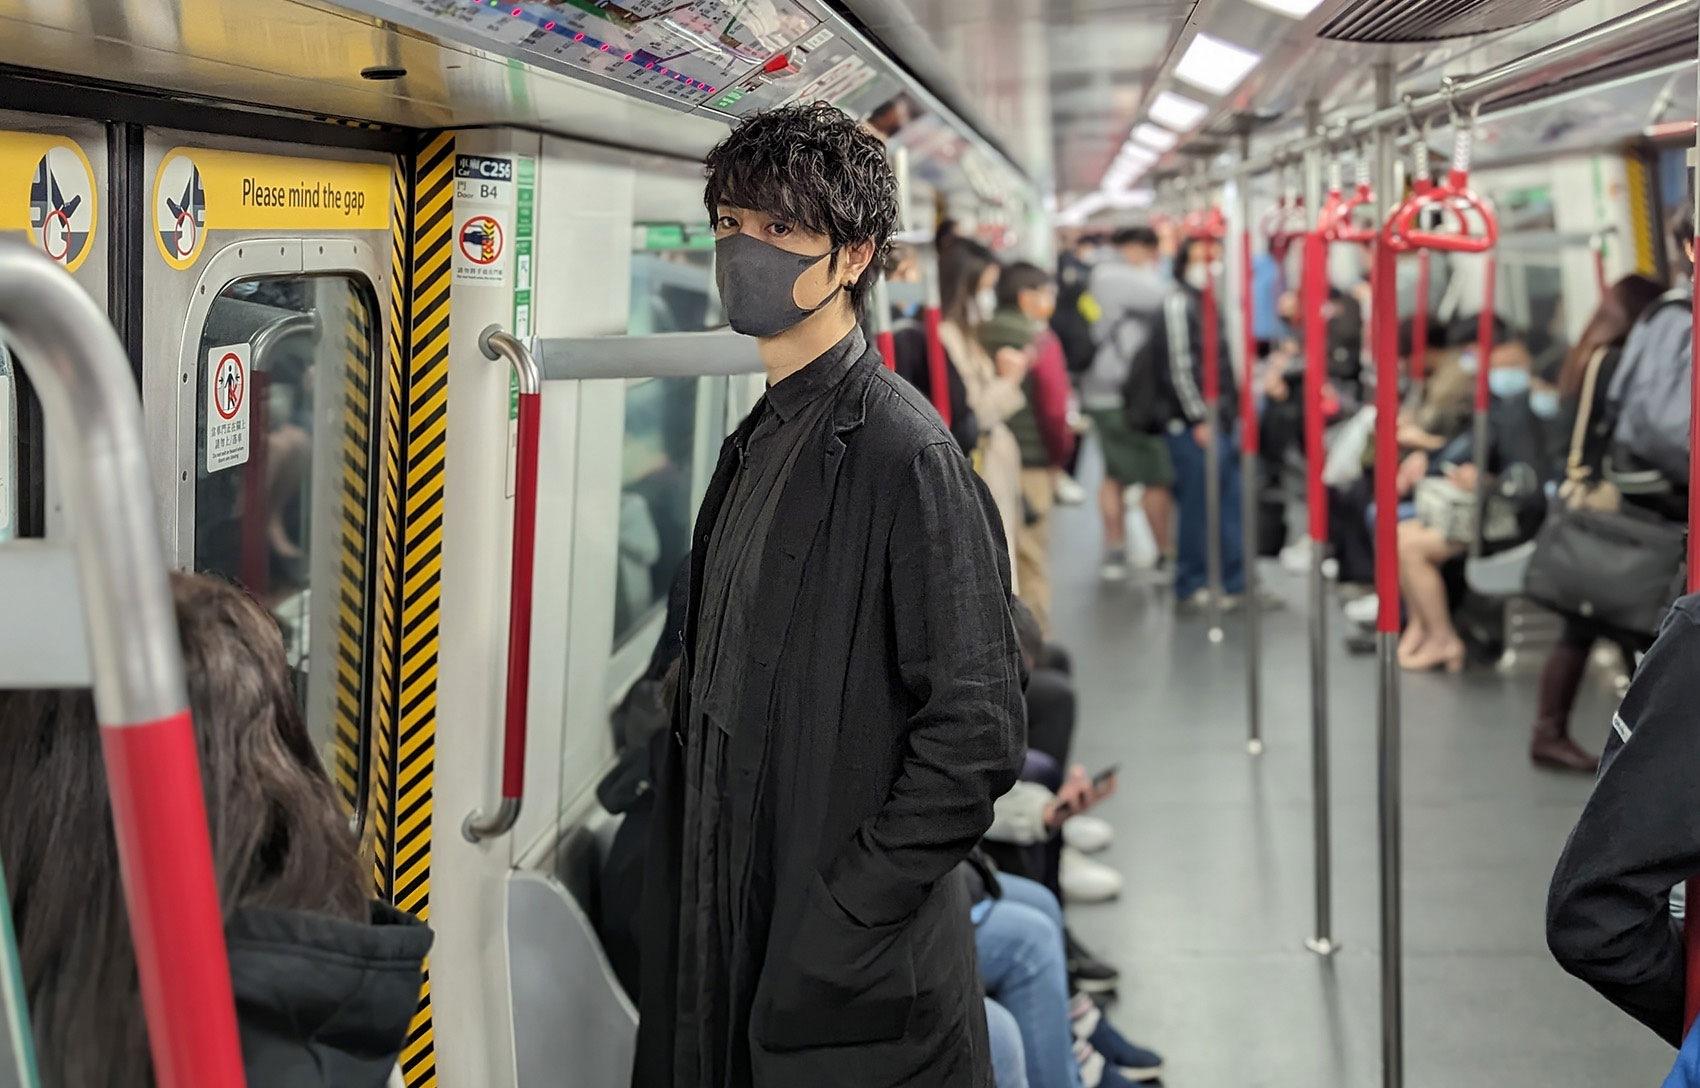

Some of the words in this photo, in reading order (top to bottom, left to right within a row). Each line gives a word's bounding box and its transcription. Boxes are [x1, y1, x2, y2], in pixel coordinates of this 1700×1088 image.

[458, 168, 471, 176] Car
[480, 160, 511, 178] C256
[242, 178, 286, 207] Please
[288, 181, 320, 208] mind
[323, 182, 342, 209] the
[344, 190, 365, 216] gap
[457, 191, 474, 199] Door
[480, 184, 498, 199] B4
